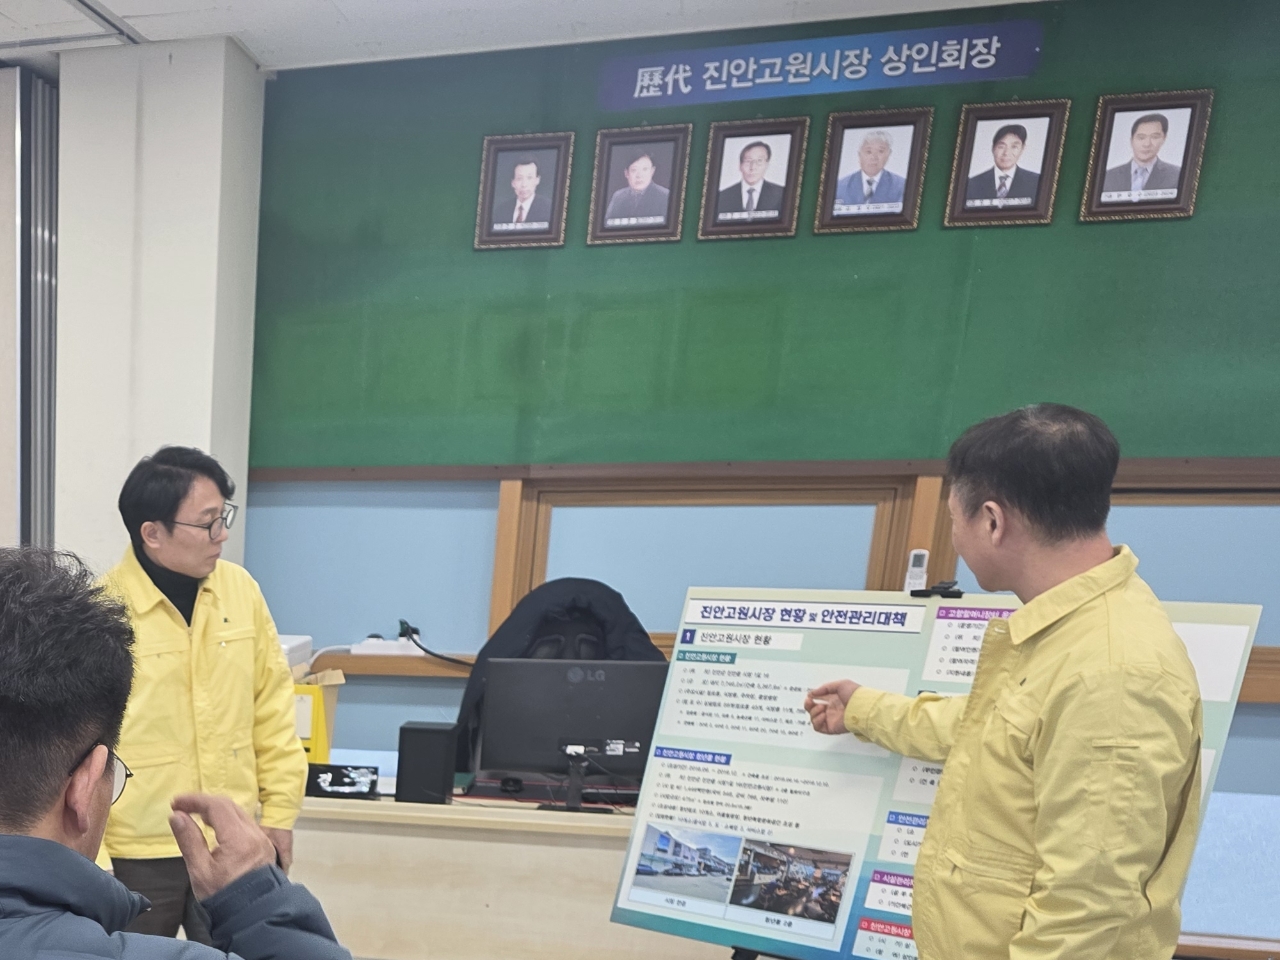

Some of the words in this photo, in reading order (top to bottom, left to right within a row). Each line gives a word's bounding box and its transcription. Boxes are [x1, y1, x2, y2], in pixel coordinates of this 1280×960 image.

[702, 47, 872, 90] 진안고원시장
[880, 36, 1001, 76] 상인회장
[700, 605, 776, 621] 진안고원시장
[779, 608, 806, 622] 현황
[821, 609, 908, 626] 안전관리대책
[700, 633, 751, 645] 진안고원시장
[753, 634, 772, 646] 현황
[586, 669, 606, 681] LG
